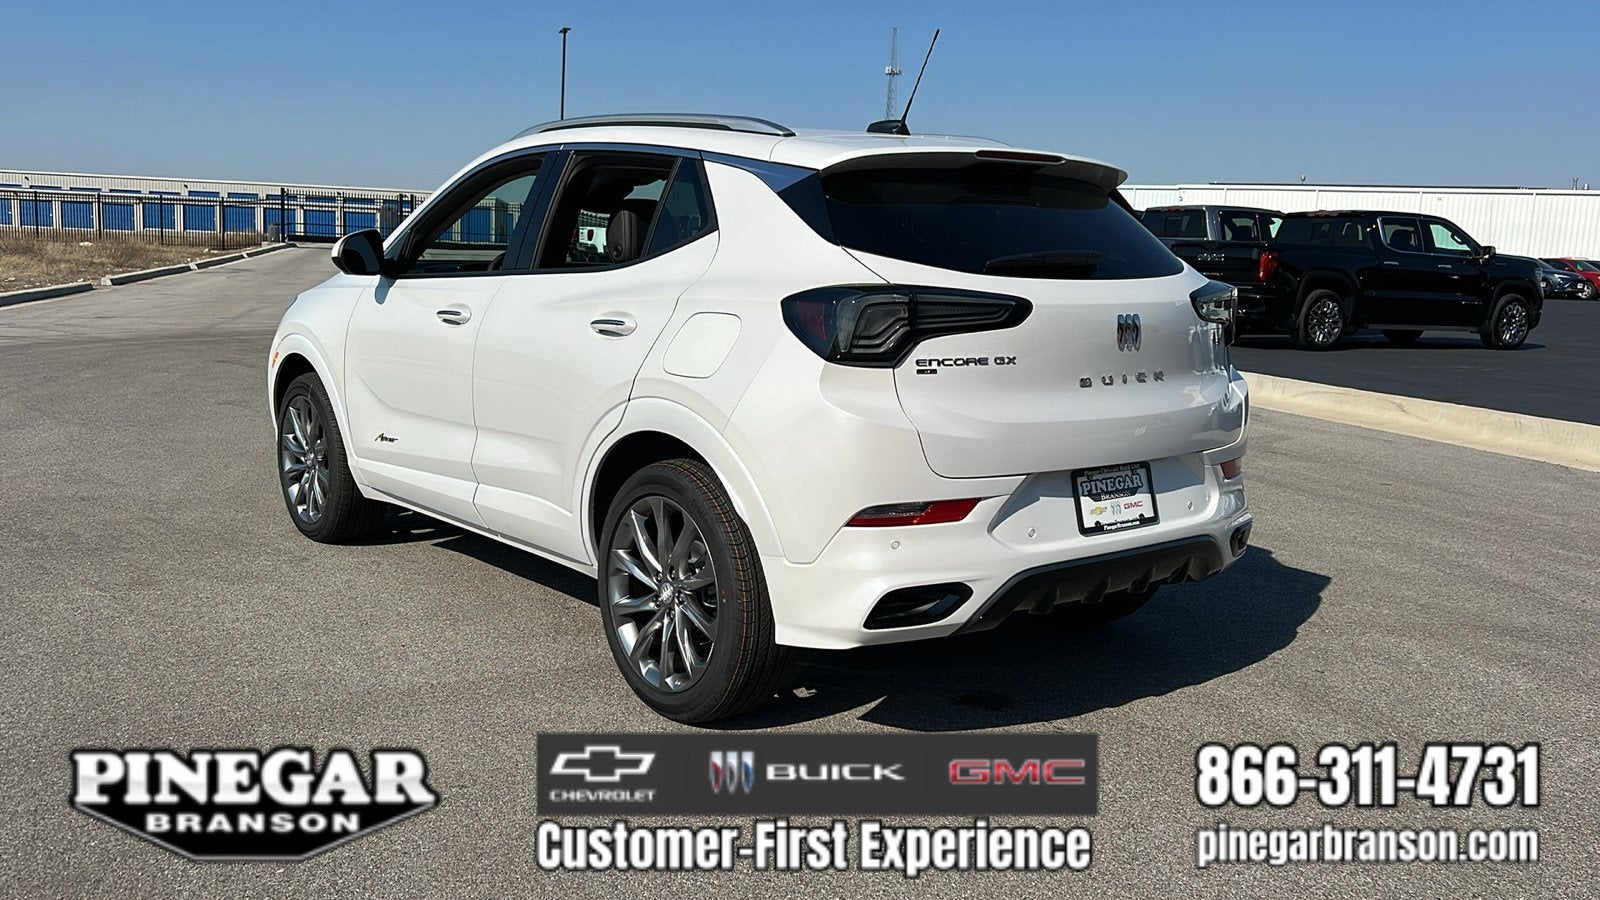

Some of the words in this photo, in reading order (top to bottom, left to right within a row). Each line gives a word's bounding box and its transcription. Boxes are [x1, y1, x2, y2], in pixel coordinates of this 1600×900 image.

[915, 358, 989, 367] ENCORE
[994, 356, 1017, 366] GX
[1079, 370, 1165, 388] BUICK
[1081, 474, 1143, 496] PINEGAR
[1123, 500, 1143, 510] GMC
